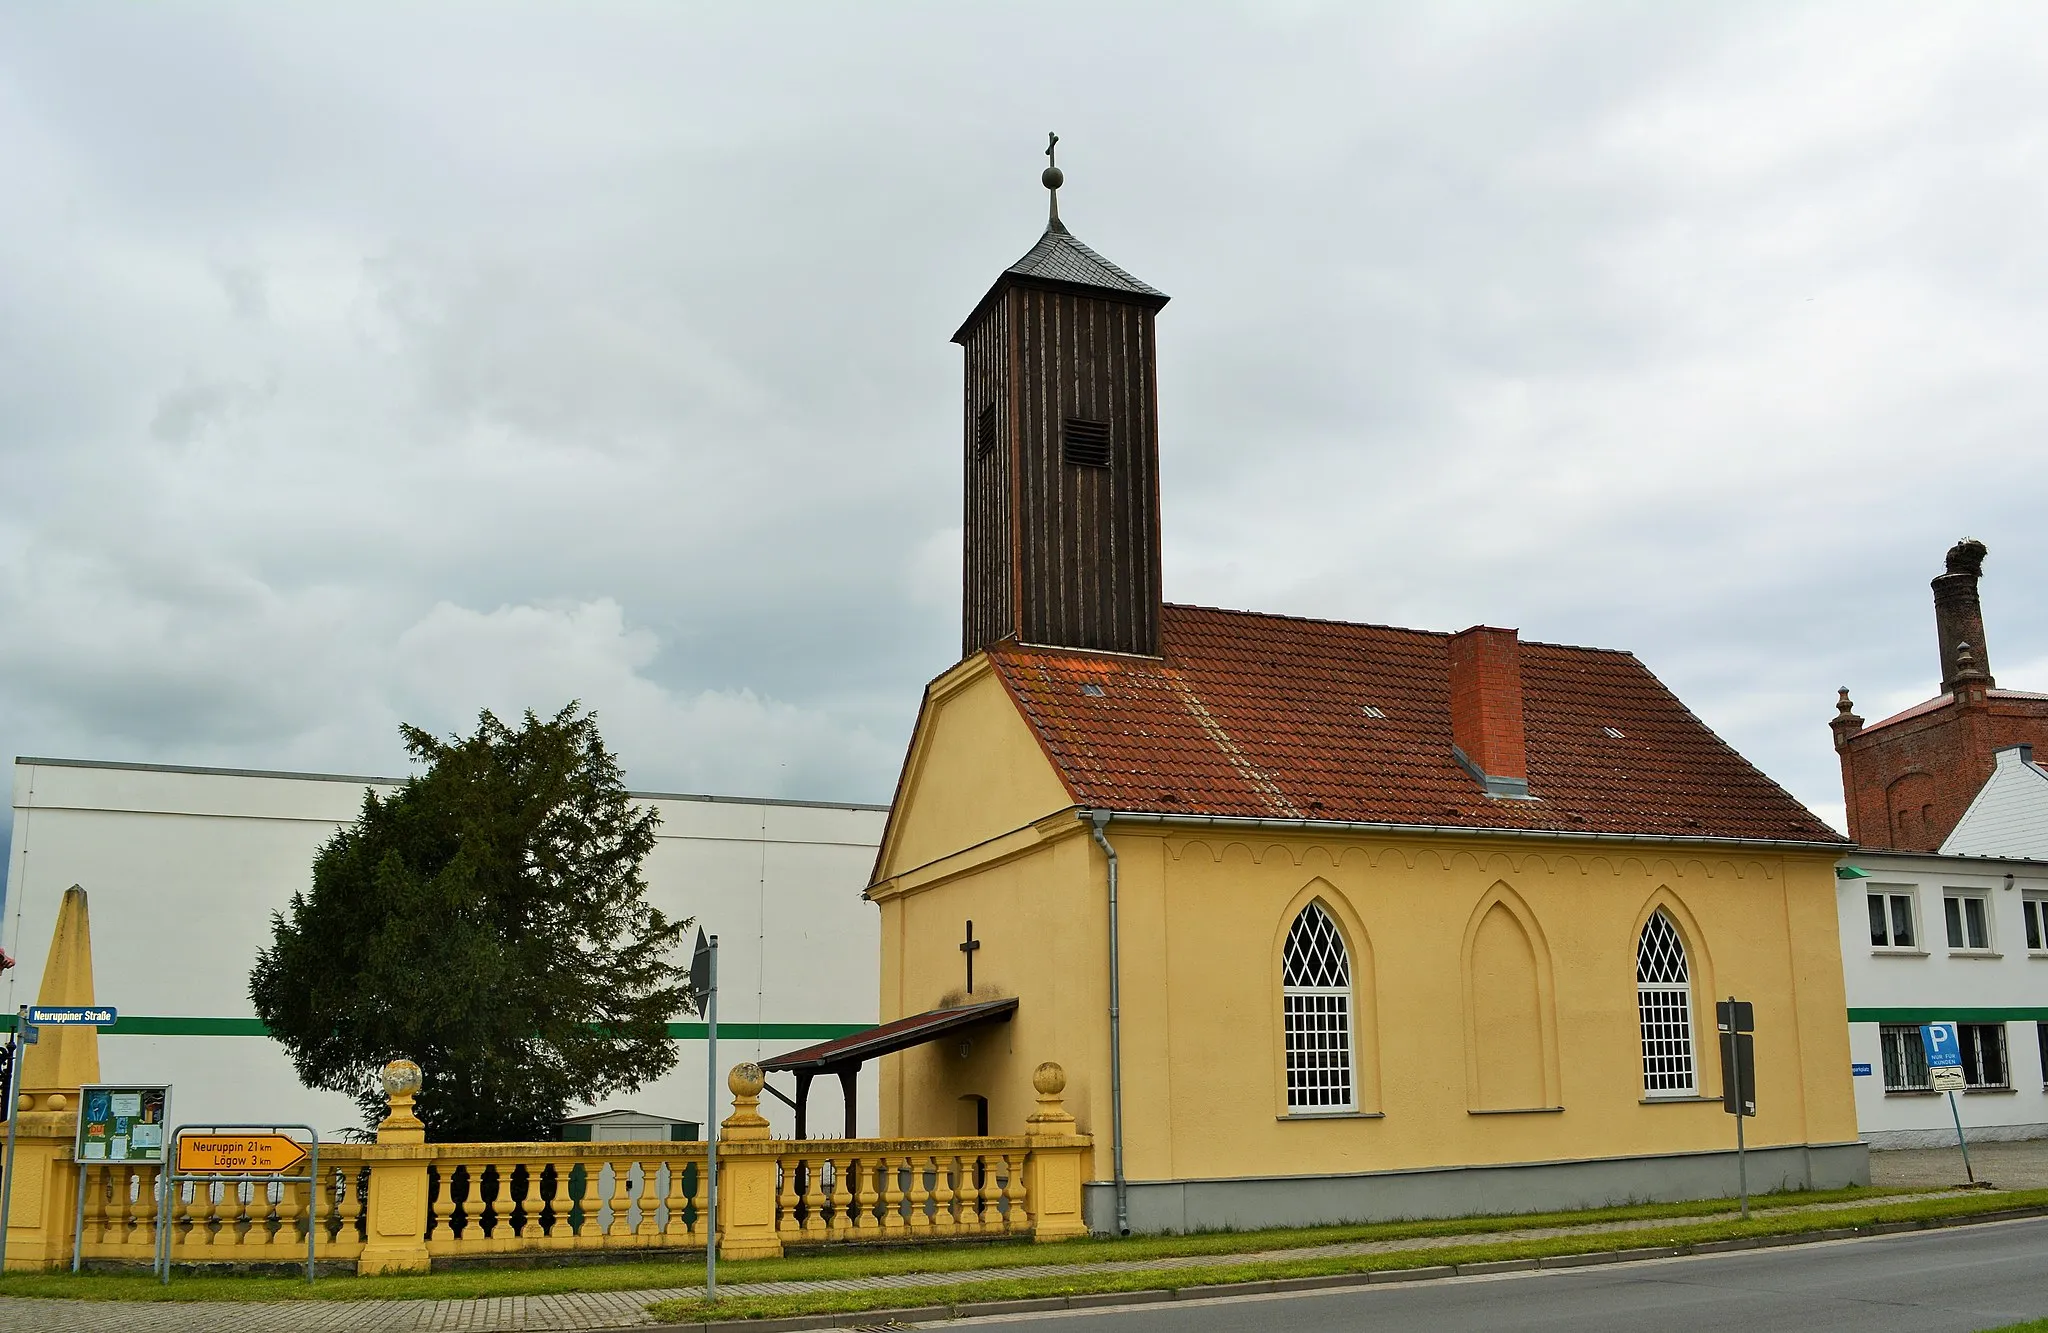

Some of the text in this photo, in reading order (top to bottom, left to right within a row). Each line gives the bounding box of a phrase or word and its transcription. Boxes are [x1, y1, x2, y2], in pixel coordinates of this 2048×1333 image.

[33, 1010, 112, 1023] Neuruppiner Straße
[1928, 1026, 1948, 1052] P
[193, 1141, 272, 1154] Neuruppin 21 km
[214, 1154, 271, 1168] Lögow 3 km
